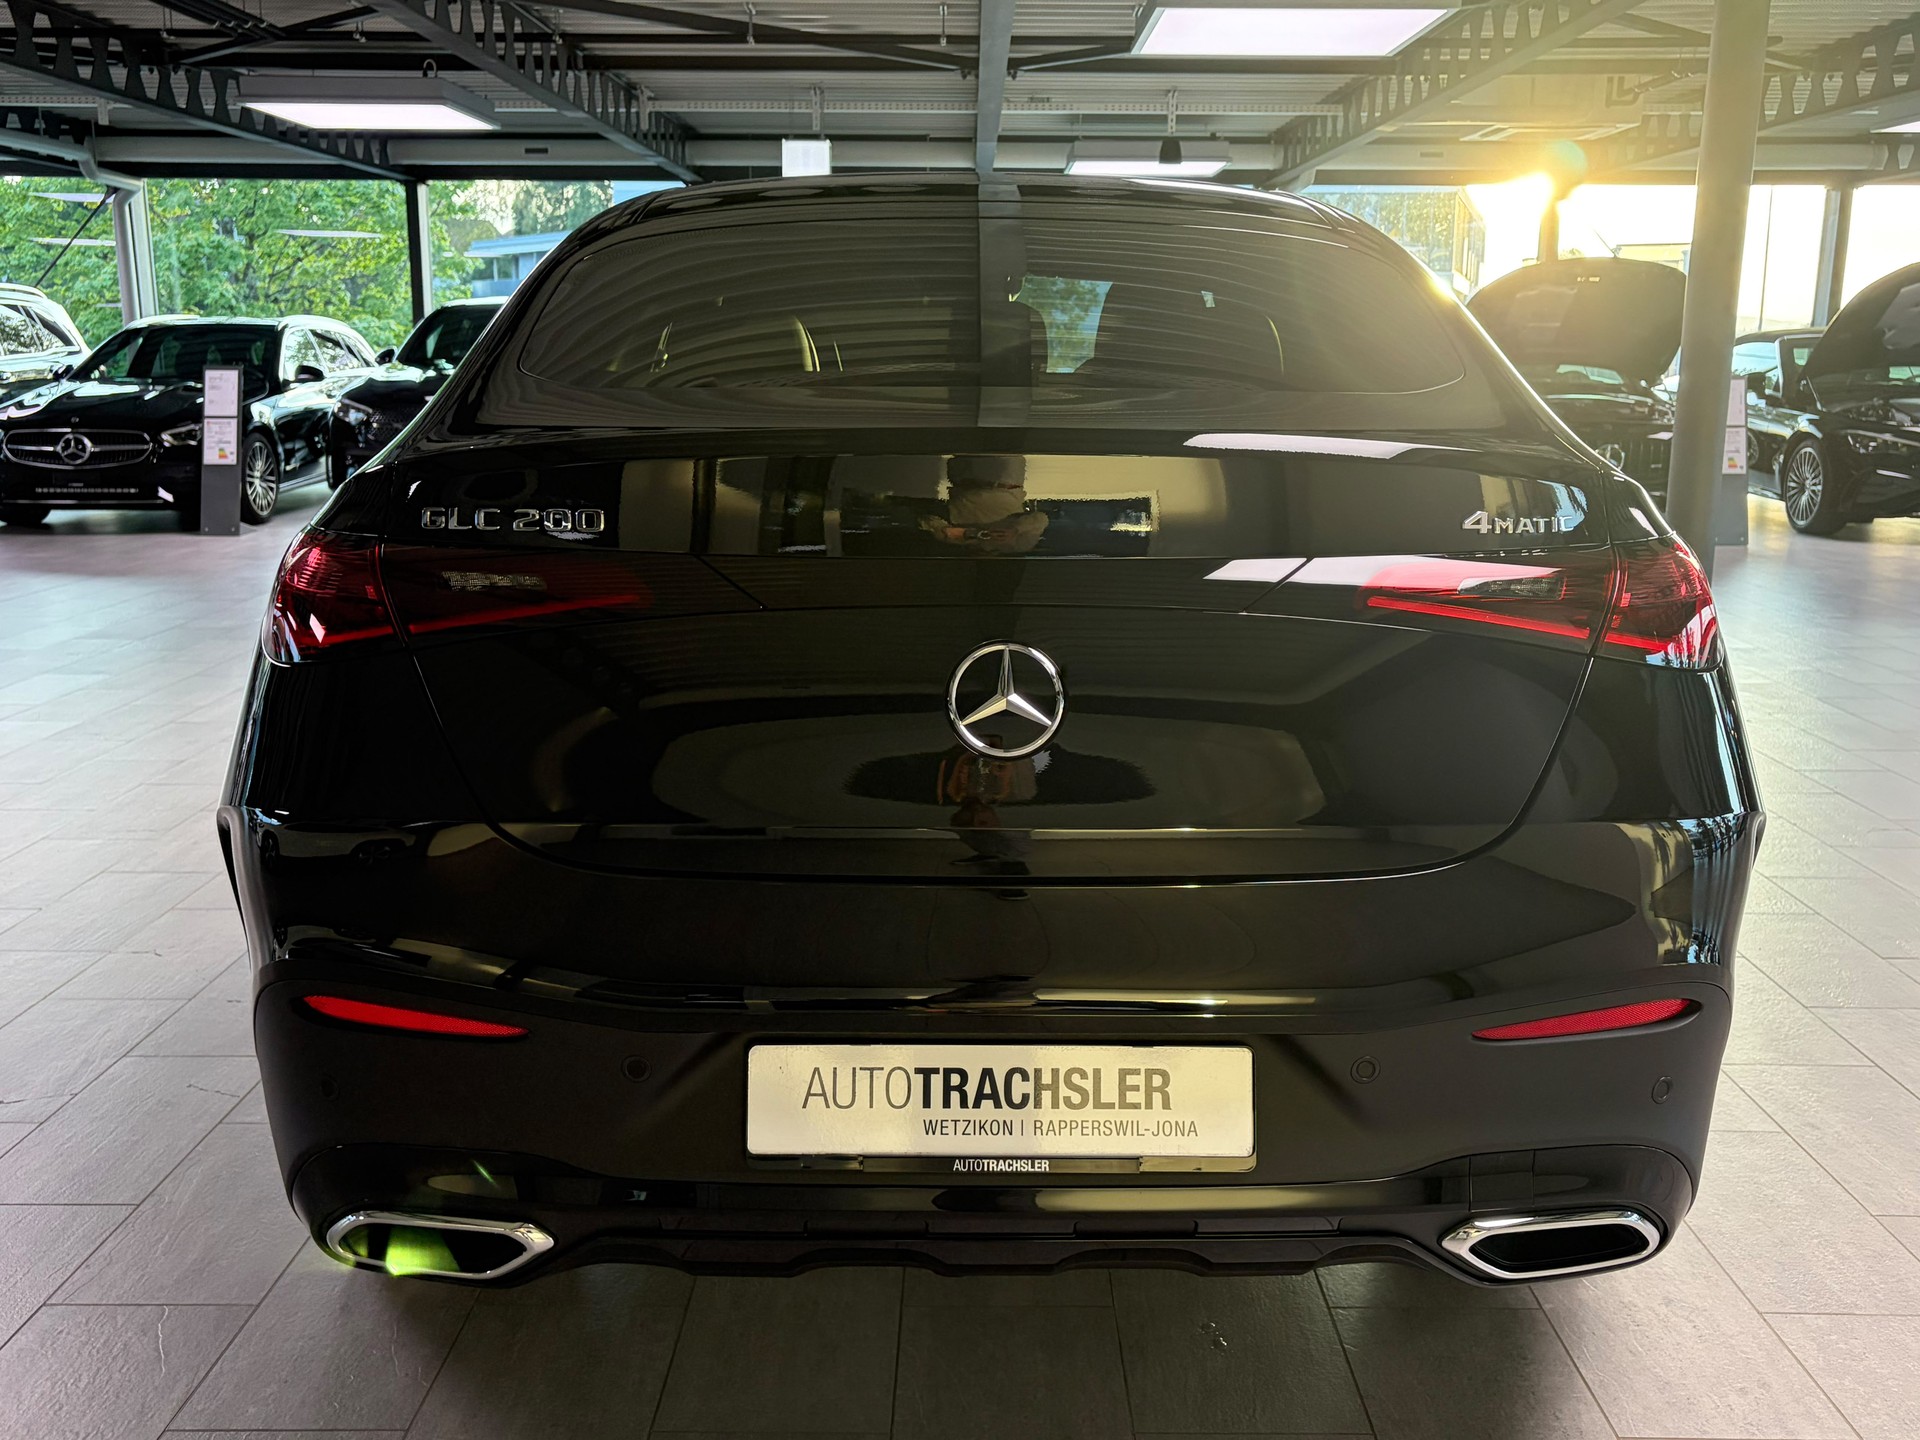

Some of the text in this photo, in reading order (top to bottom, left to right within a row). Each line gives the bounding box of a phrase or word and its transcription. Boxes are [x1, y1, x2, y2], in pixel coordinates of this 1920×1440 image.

[421, 506, 605, 532] GLC 200
[1462, 510, 1575, 535] 4MATIC
[801, 1066, 1172, 1110] AUTOTRACHSLER
[923, 1119, 1013, 1136] WETZIKON
[1033, 1119, 1199, 1137] RAPPERSWIL-JONA
[953, 1158, 1050, 1173] AUTOTRACHSLER
